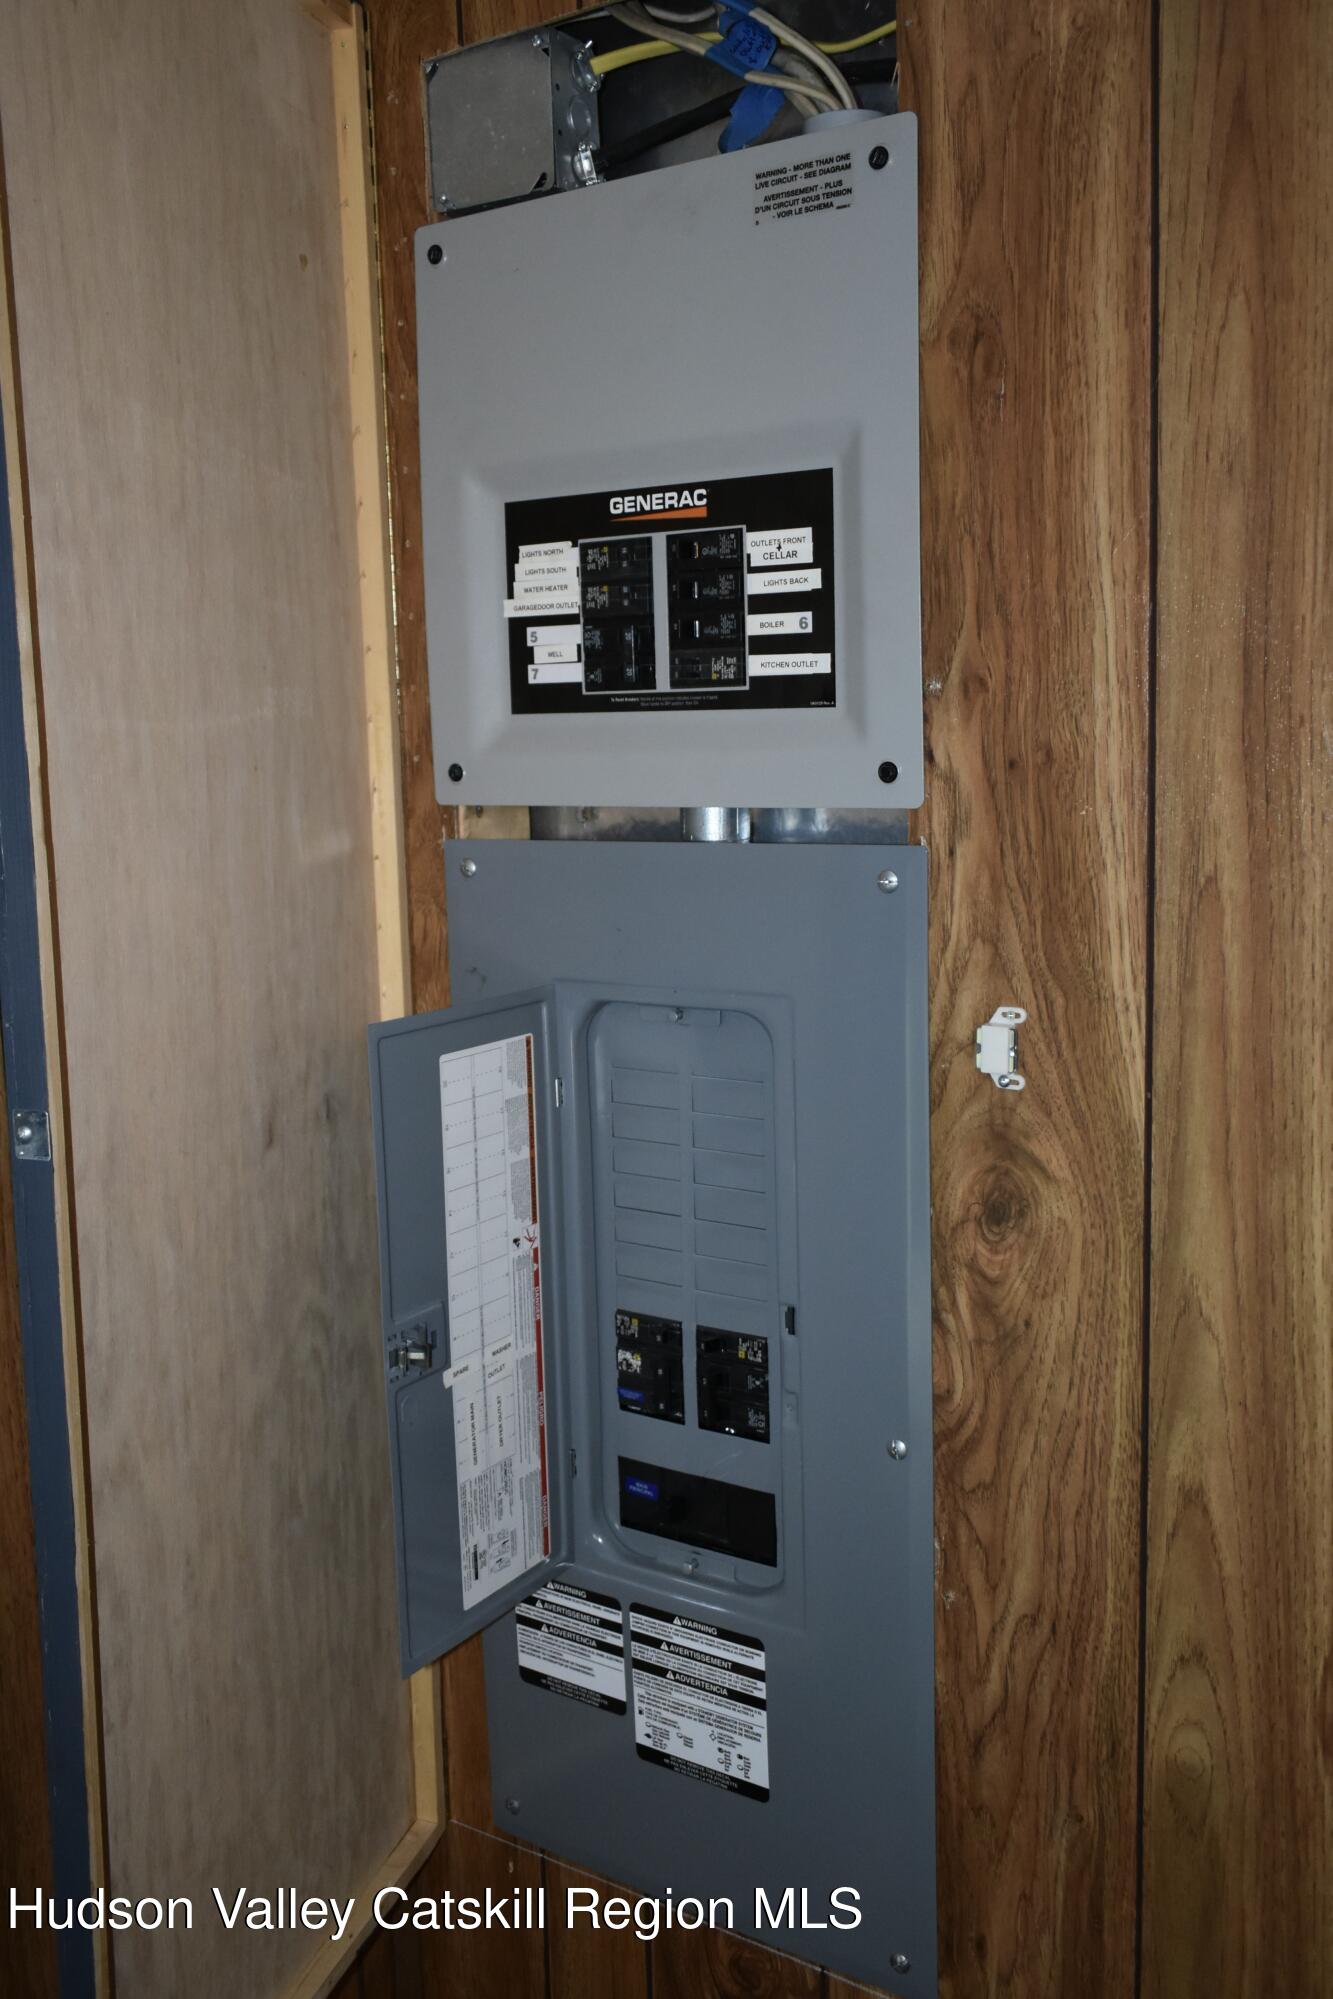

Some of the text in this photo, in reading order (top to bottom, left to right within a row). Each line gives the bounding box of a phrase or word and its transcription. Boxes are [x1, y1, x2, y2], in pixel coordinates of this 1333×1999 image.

[756, 167, 787, 180] WARNING
[793, 161, 813, 172] MORE
[816, 156, 834, 167] THAN
[836, 153, 851, 163] ONE
[755, 181, 769, 190] LIVE
[771, 174, 798, 186] CIRCUIT
[804, 170, 817, 179] SEE
[819, 163, 852, 176] DIAGRAM
[764, 185, 818, 202] AVERTISSEMENT
[824, 180, 843, 190] PLUS
[755, 188, 852, 214] D'UN CIRCUIT SOUS TENSION
[777, 210, 793, 218] VOIR
[794, 207, 803, 215] LE
[804, 201, 834, 213] SCHEMA
[609, 488, 707, 514] GENERAC
[751, 536, 806, 548] OUTLETS FRONT
[762, 550, 798, 560] CELLAR
[525, 567, 566, 576] LIGHTS SOUTH
[524, 584, 568, 594] WATER HEATER
[763, 576, 809, 587] LIGHTS BACK
[556, 601, 578, 609] OUTLET
[759, 616, 809, 630] BOILER 6
[530, 631, 538, 643] 5
[547, 650, 563, 658] WELL
[760, 660, 818, 669] KITCHEN OUTLET
[531, 667, 539, 681] 7
[553, 1582, 587, 1598] WARNING
[543, 1602, 601, 1625] AVERTISSEMENT
[680, 1618, 718, 1636] WARNING
[549, 1626, 598, 1648] ADVERTENCIA
[669, 1645, 733, 1671] AVERTISSEMENT
[675, 1673, 728, 1697] ADVERTENCIA
